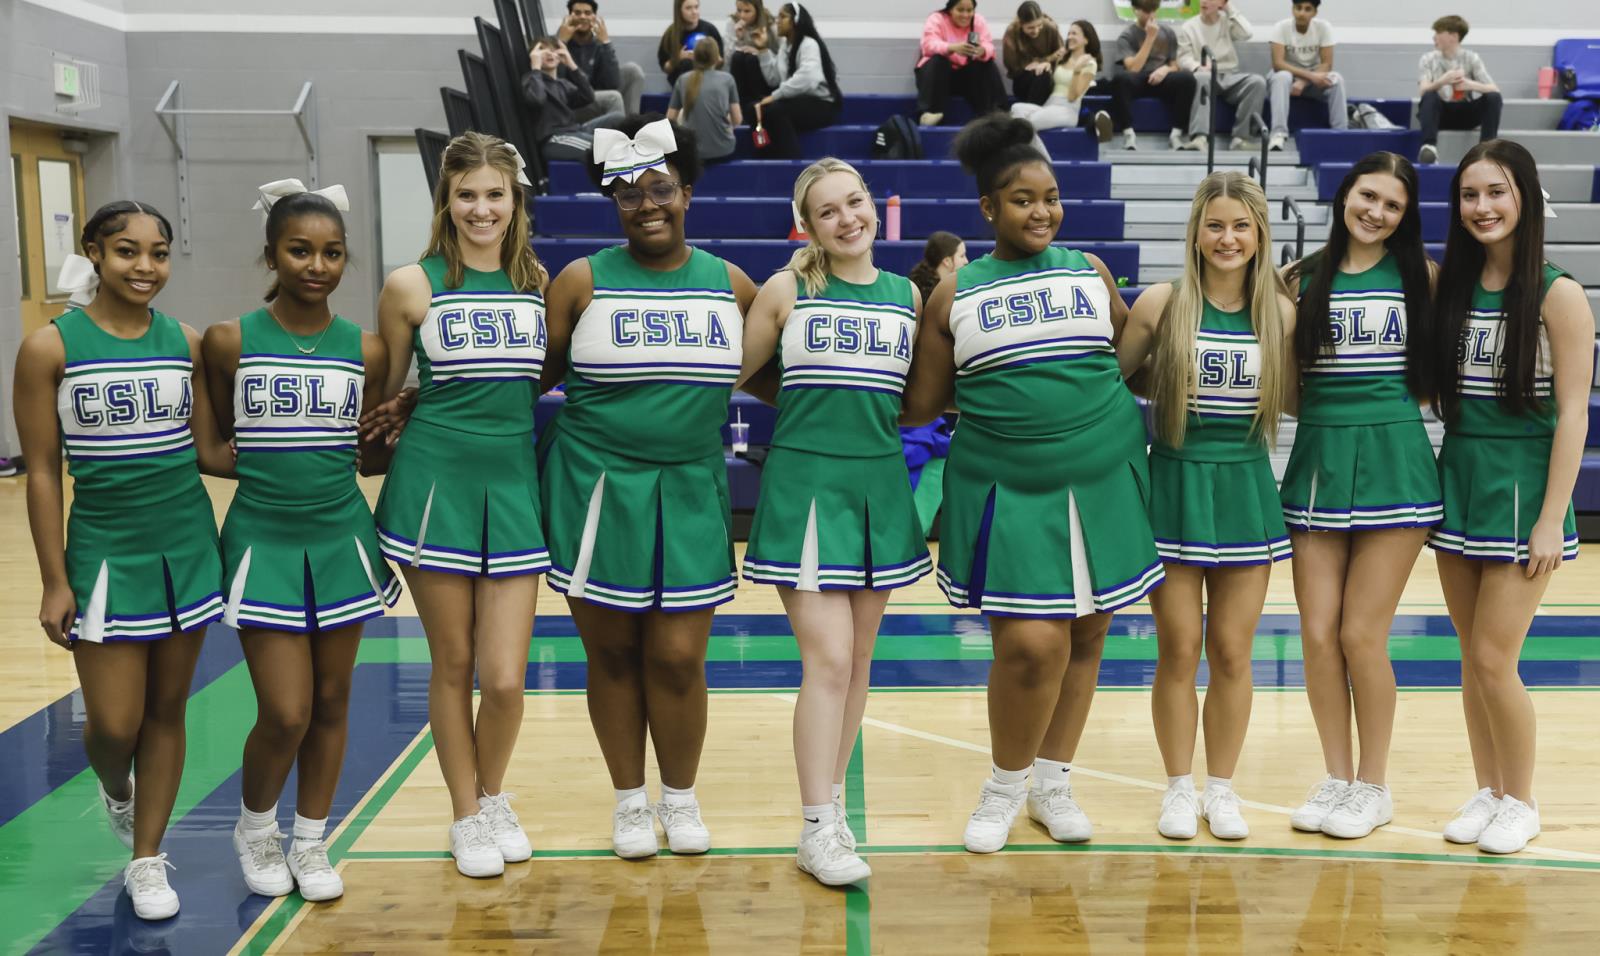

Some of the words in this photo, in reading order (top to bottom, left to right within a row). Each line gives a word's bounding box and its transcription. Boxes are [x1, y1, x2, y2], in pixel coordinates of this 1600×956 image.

[438, 309, 547, 350] CSLA
[612, 309, 730, 349] CSLA
[977, 286, 1098, 333] CSLA
[1329, 307, 1405, 345] SLA
[805, 315, 912, 364] CSLA
[1187, 348, 1262, 389] SL
[71, 377, 192, 427] CSLA
[241, 374, 361, 418] CSLA
